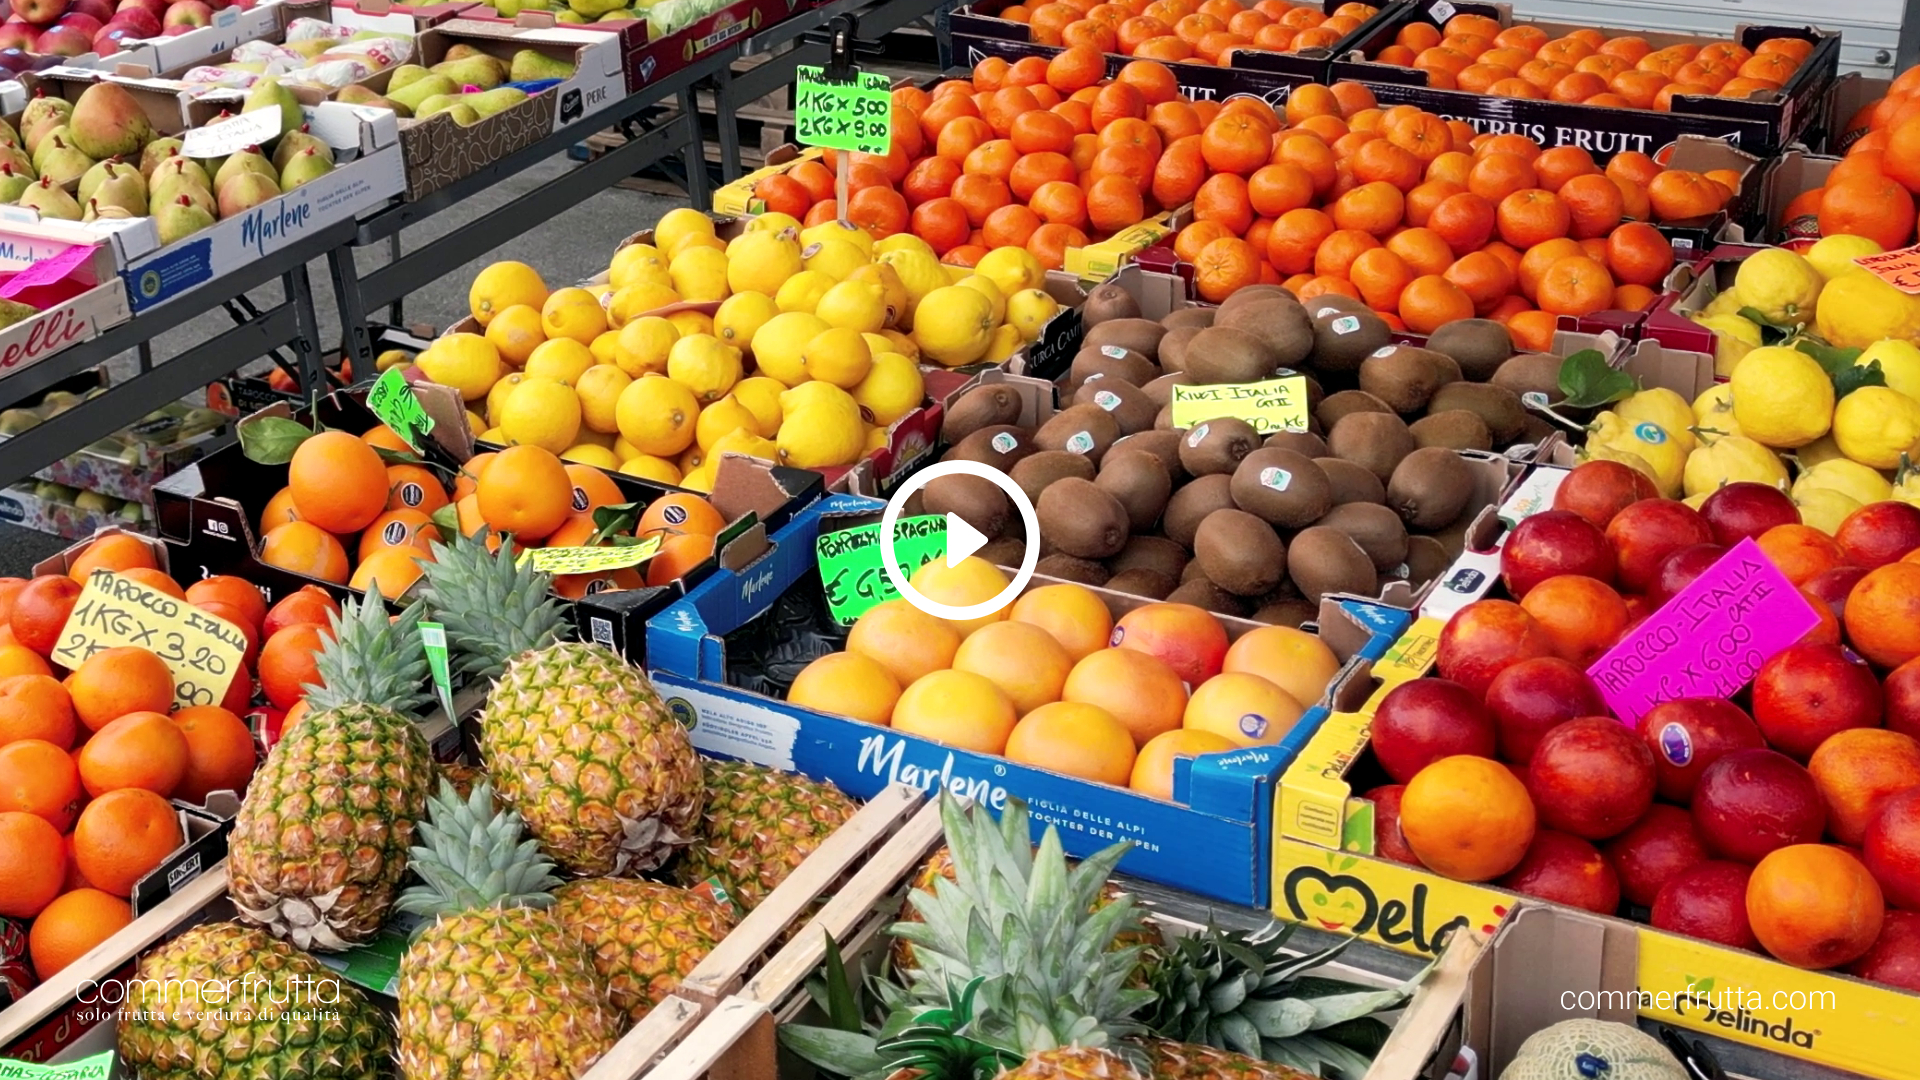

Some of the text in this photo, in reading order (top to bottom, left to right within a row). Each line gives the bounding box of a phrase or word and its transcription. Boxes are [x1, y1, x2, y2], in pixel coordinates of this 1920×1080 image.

[585, 86, 607, 107] PERE
[1555, 126, 1653, 154] FRUIT
[241, 199, 311, 256] Marlene
[91, 569, 179, 618] TAROCCO
[156, 632, 226, 676] 3.20
[1702, 623, 1752, 671] 6,00
[857, 733, 1008, 811] Marlene
[1028, 797, 1146, 836] FIGLIA DELLE ALPI
[1028, 810, 1085, 833] TOCHTER
[1090, 826, 1114, 841] DER
[1673, 993, 1814, 1050] Melinda
